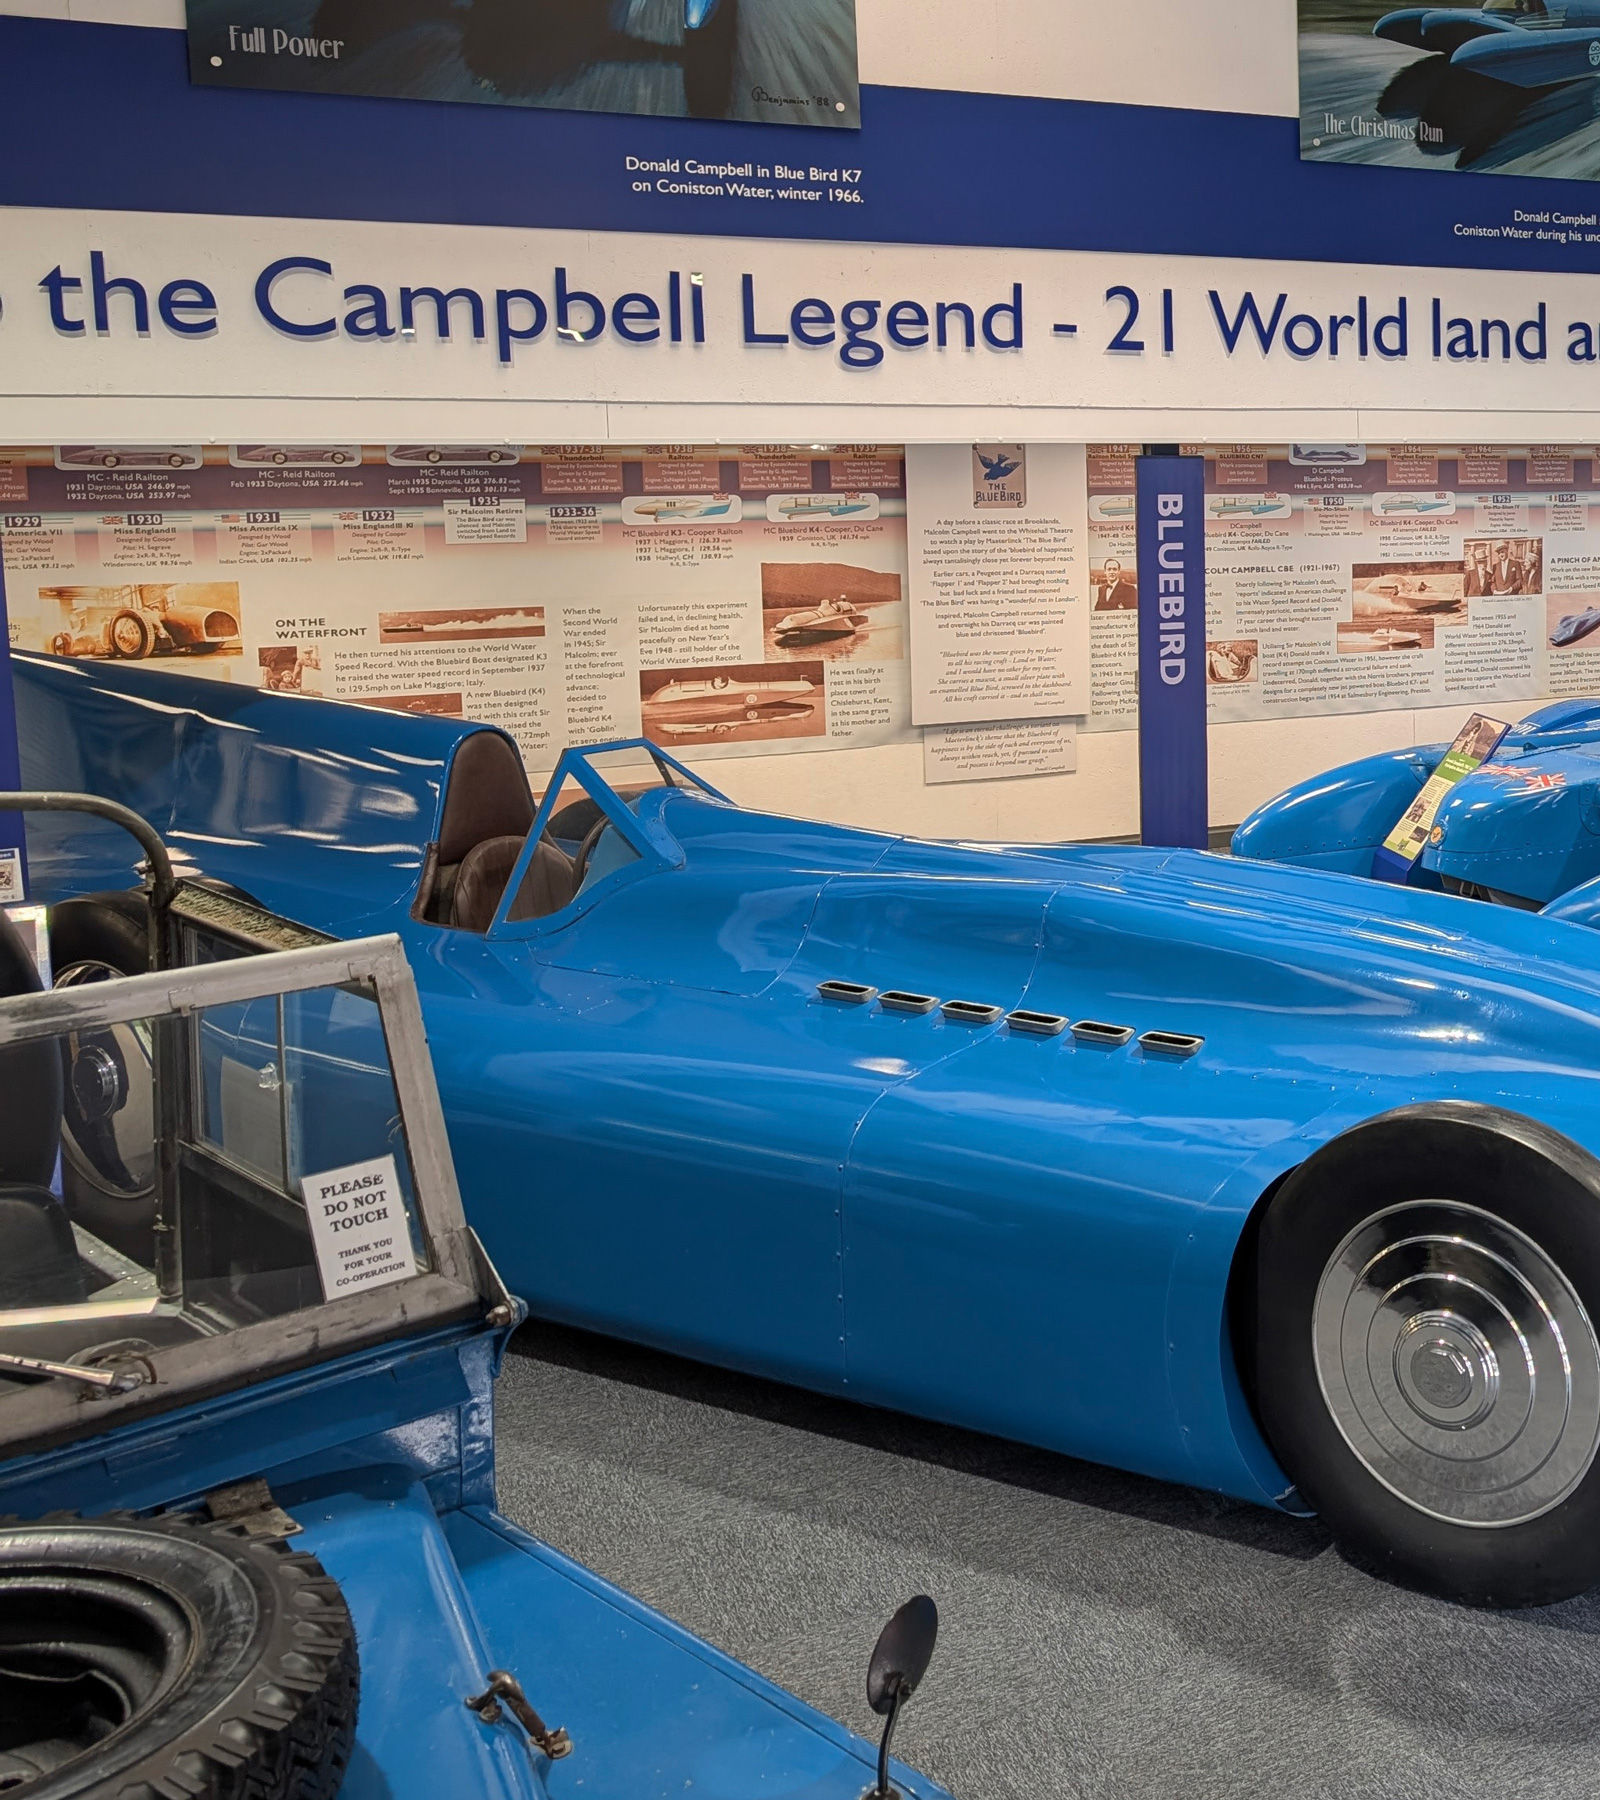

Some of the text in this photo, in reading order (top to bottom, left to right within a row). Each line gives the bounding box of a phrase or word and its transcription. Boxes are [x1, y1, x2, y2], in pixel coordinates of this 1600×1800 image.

[229, 25, 344, 59] Full Power
[1324, 112, 1443, 143] The Christmas Run
[626, 156, 862, 183] Donald Campbell in Blue Bird K7
[632, 179, 865, 203] on Coniston Water, winter 1966.
[1514, 209, 1549, 223] Donald
[1552, 212, 1596, 227] Campbell
[1453, 223, 1500, 237] Coniston
[1501, 226, 1533, 239] Water
[1535, 228, 1566, 244] during
[1568, 229, 1582, 241] his
[38, 250, 217, 333] the
[254, 257, 706, 362] Campbell
[741, 273, 1024, 367] Legend
[1104, 285, 1173, 352] 21
[1207, 290, 1408, 357] World
[1431, 298, 1547, 360] land
[86, 473, 104, 481] MC
[112, 473, 134, 481] Reid
[135, 473, 169, 481] Railton
[988, 483, 1007, 491] THE
[7, 517, 40, 526] 1929
[129, 515, 161, 524] 1930
[249, 512, 278, 522] 1931
[365, 511, 393, 521] 1932
[1204, 564, 1340, 575] COLM CAMPBELL CBE (1921-1967)
[1557, 556, 1579, 565] PINCH
[1157, 494, 1186, 685] BLUEBIRD
[588, 607, 601, 615] the
[275, 617, 326, 628] ON THE
[563, 617, 618, 627] Second World
[275, 627, 368, 640] WATERFRONT
[564, 628, 606, 637] War ended
[320, 1174, 384, 1199] PLEASE
[323, 1190, 387, 1216] DO NOT
[329, 1207, 389, 1232] TOUCH
[337, 1238, 393, 1259] THANK YOU
[344, 1252, 393, 1271] FOR YOUR
[336, 1261, 406, 1287] CO-OPERATION
